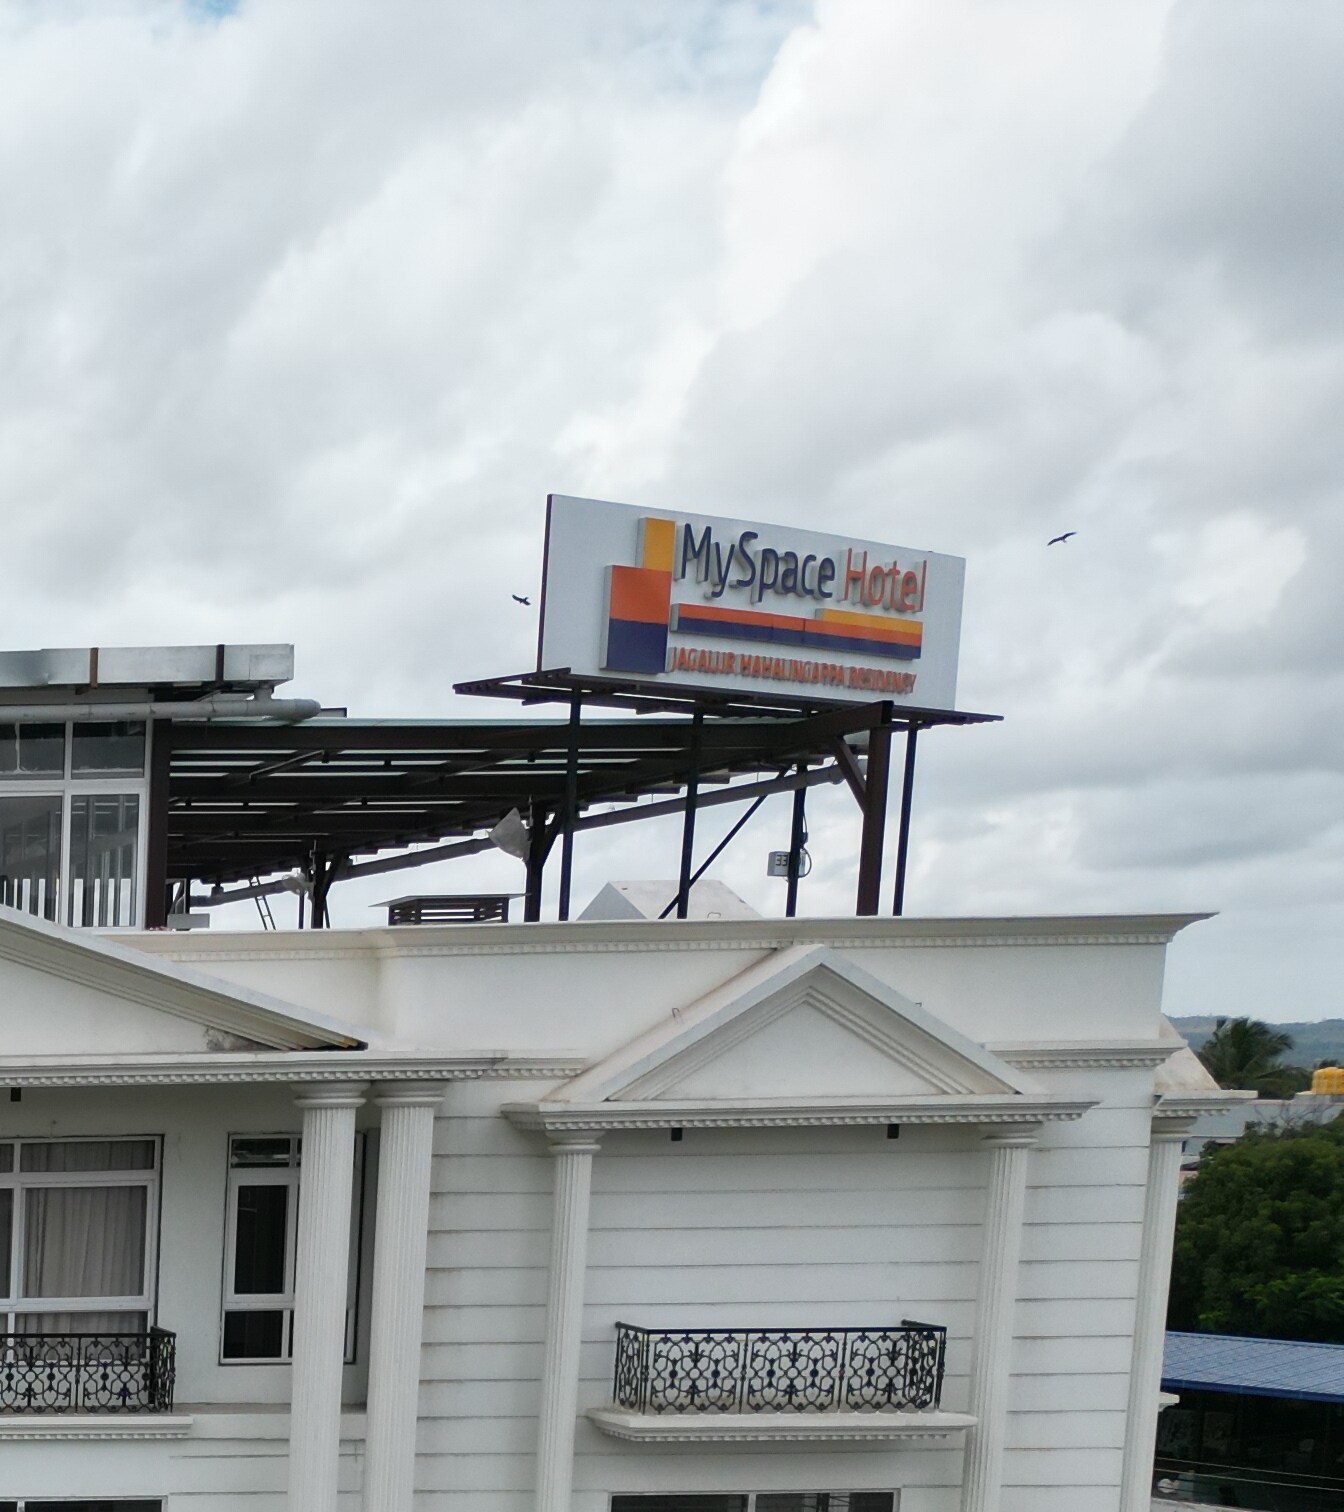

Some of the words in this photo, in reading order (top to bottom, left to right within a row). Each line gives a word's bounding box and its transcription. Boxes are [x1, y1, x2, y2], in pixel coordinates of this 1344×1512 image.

[681, 523, 836, 602] MySpace
[844, 547, 928, 612] Hotel
[672, 647, 736, 675] JAGALUR
[848, 667, 917, 694] RESIDENCY
